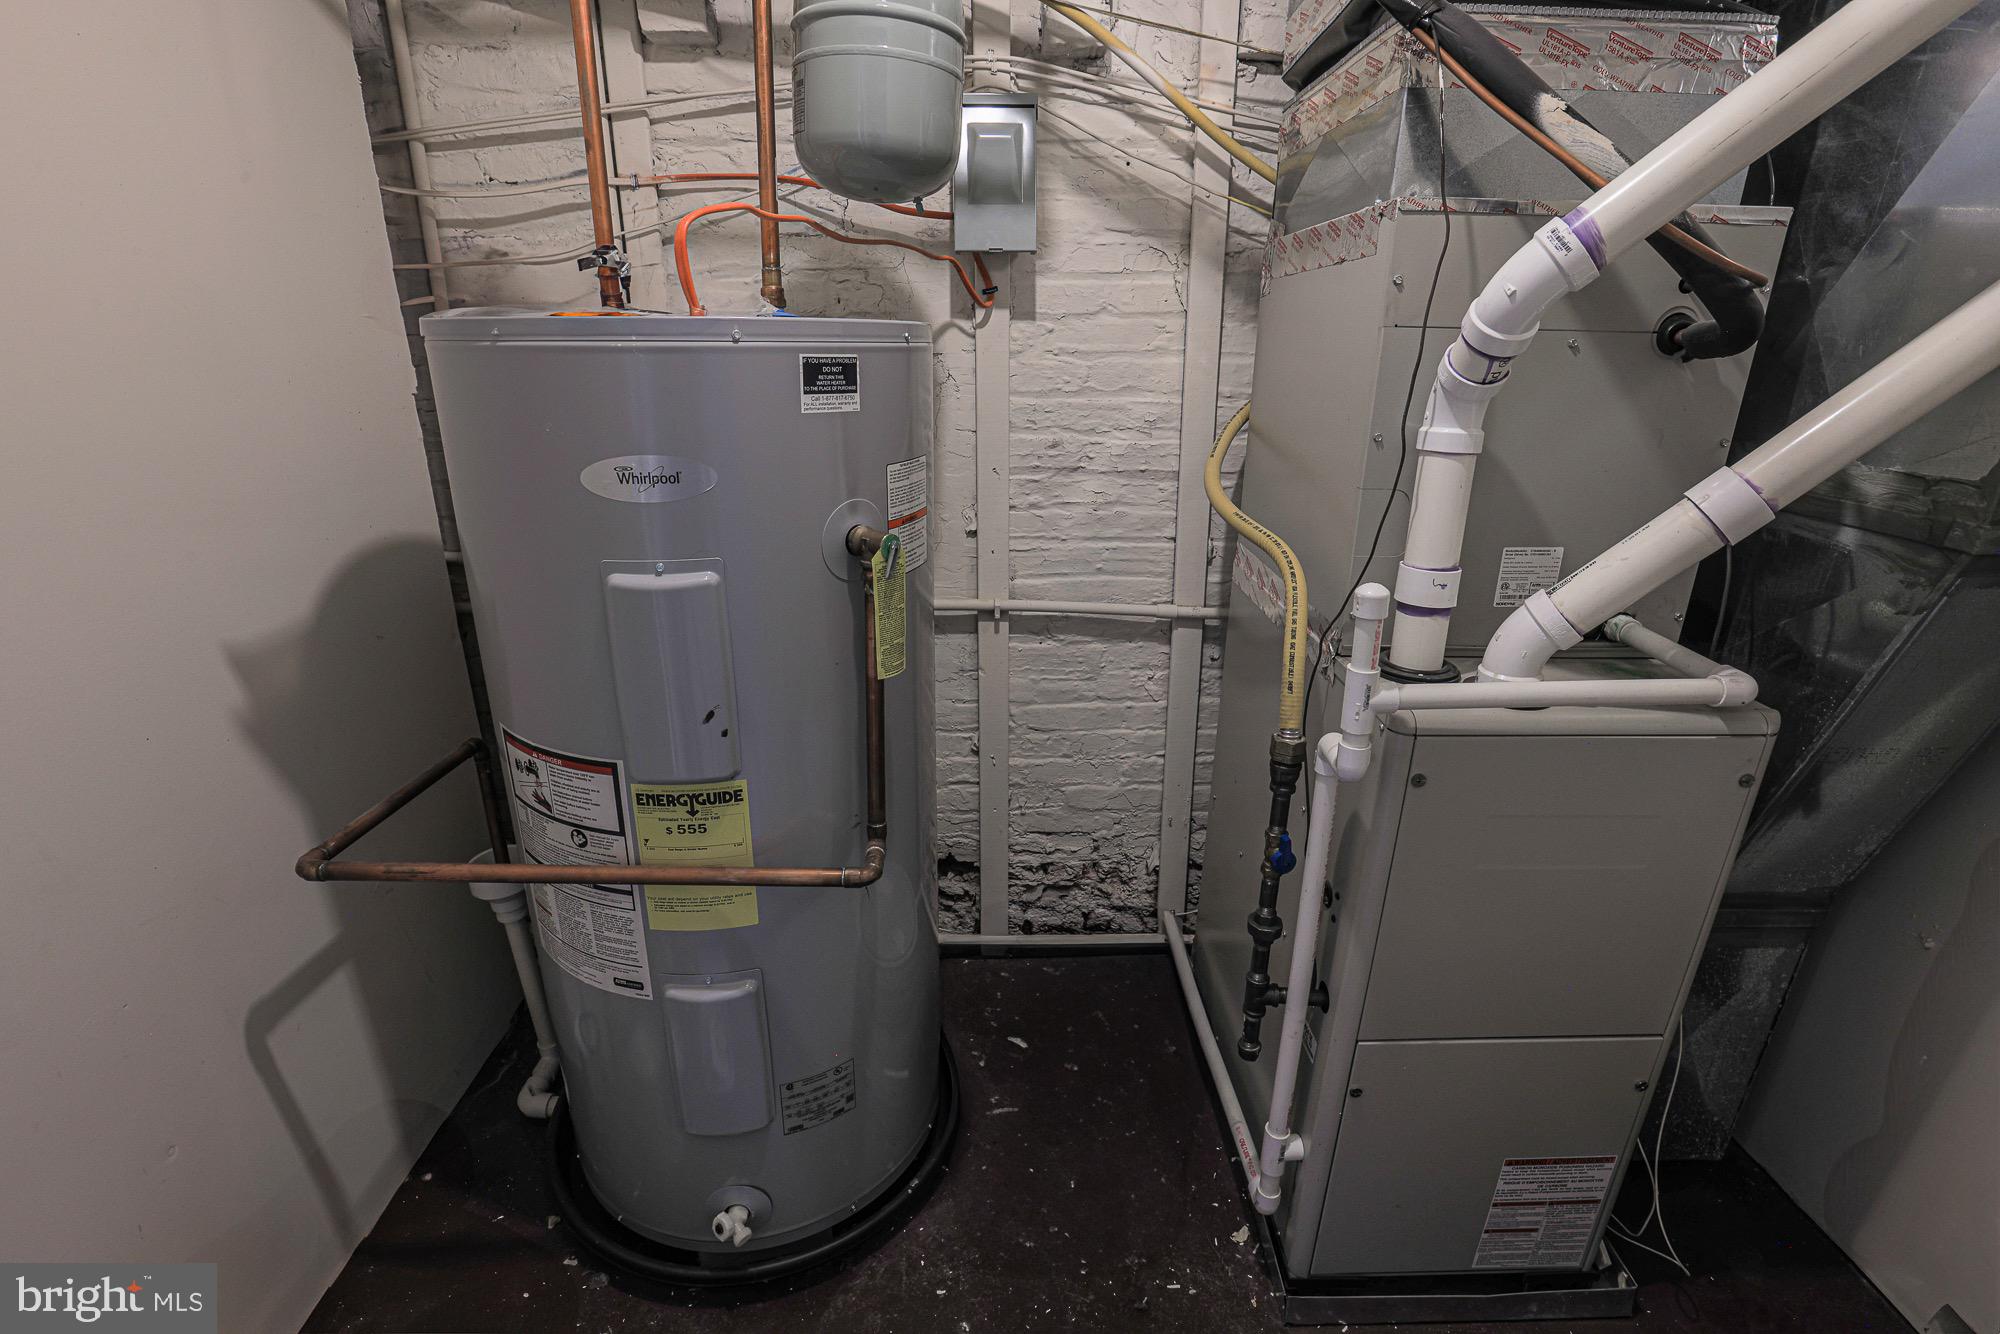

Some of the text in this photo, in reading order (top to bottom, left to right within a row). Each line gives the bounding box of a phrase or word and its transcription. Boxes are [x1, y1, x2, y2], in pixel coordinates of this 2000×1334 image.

[1635, 22, 1665, 40] WEATHER
[1542, 38, 1571, 57] UL181A-P
[1546, 29, 1591, 59] VentureTape
[1604, 44, 1625, 59] 1581A
[1608, 33, 1653, 62] VentureTape
[1679, 36, 1723, 63] VentureTape
[1539, 46, 1570, 68] UL181B-FX
[616, 472, 680, 489] Whirlpool
[538, 753, 562, 766] DANGER
[635, 788, 744, 807] ENERGYGUIDE
[665, 823, 708, 836] $ 555
